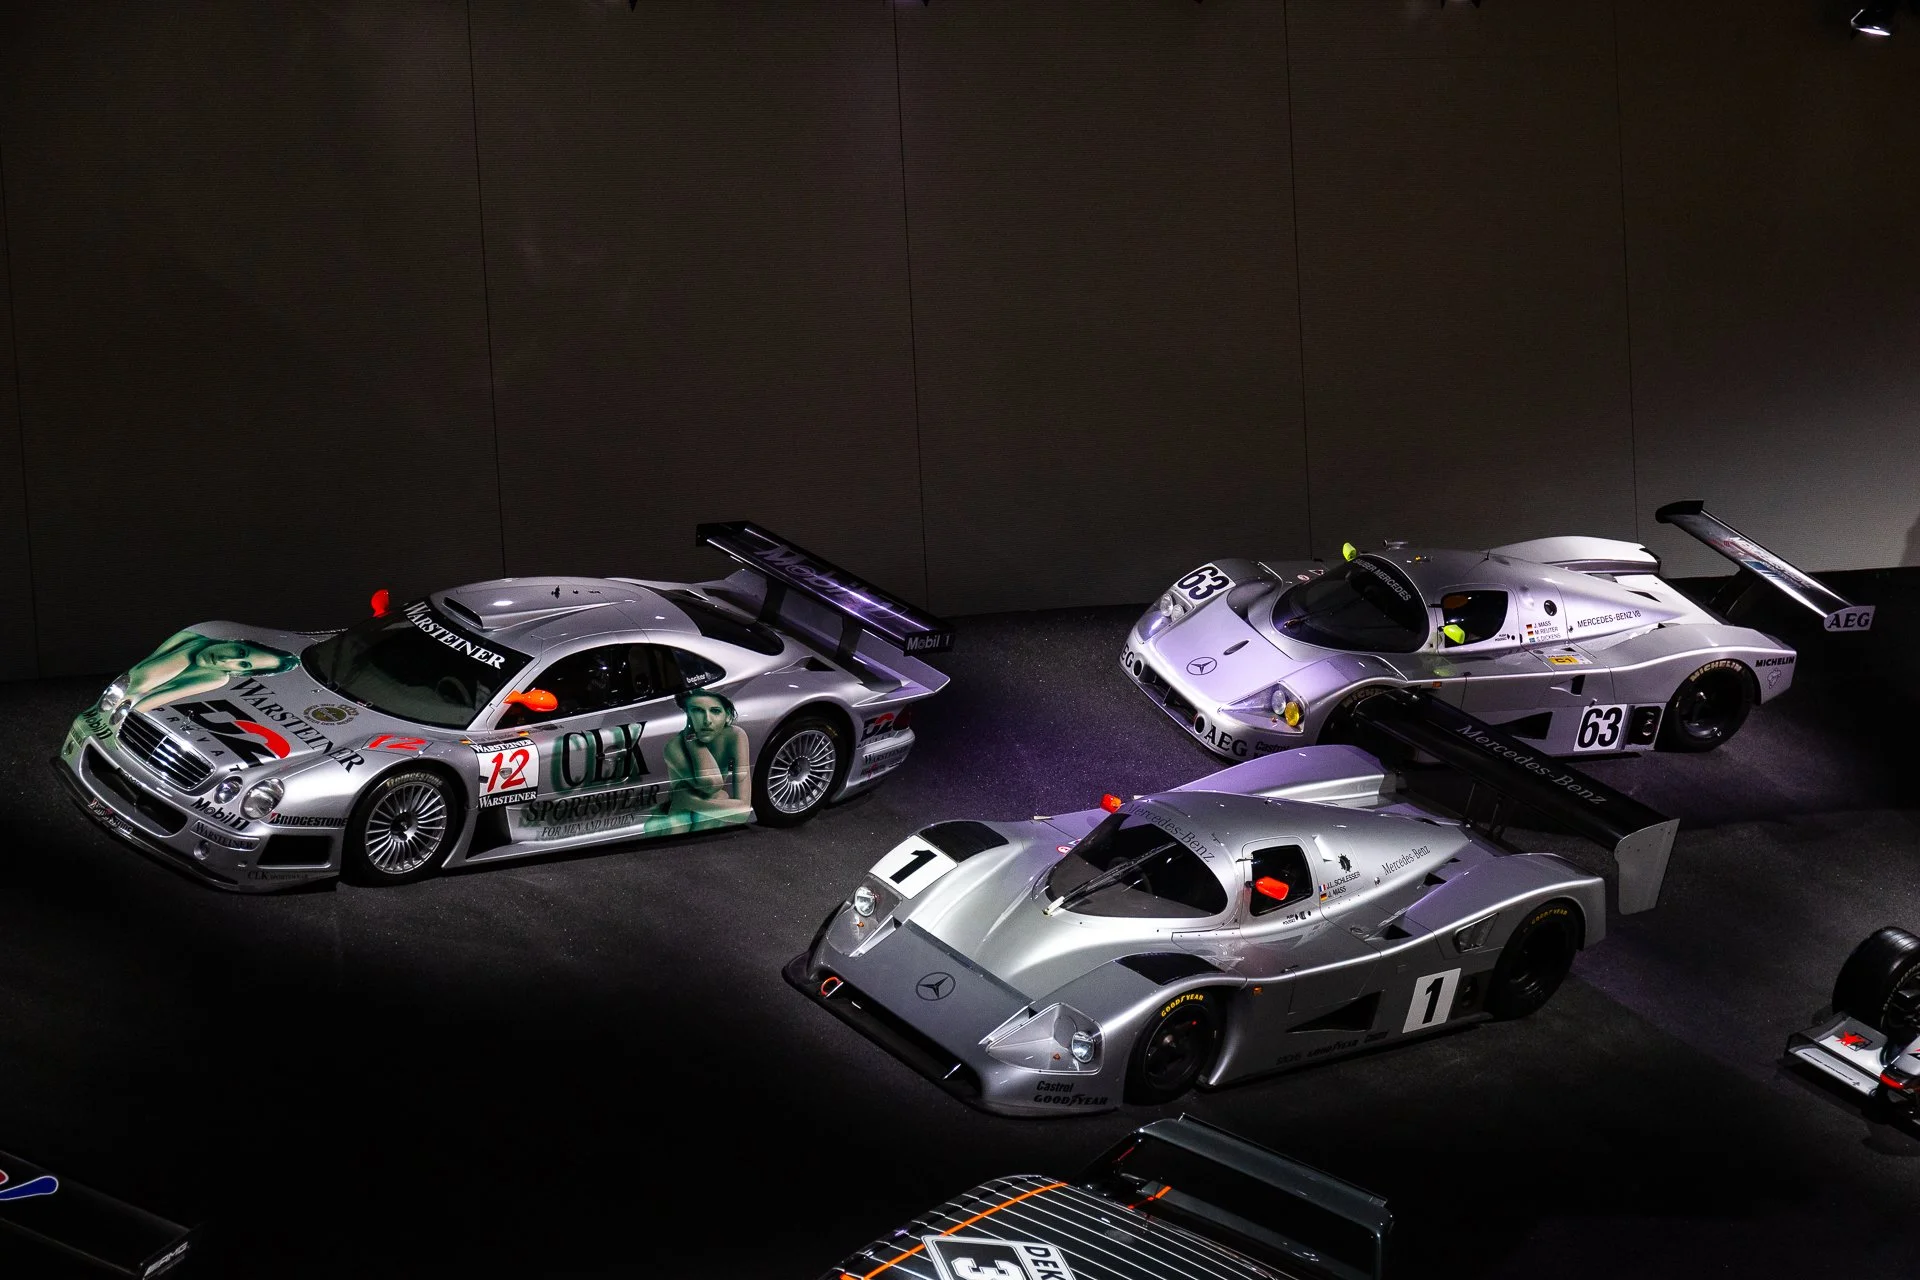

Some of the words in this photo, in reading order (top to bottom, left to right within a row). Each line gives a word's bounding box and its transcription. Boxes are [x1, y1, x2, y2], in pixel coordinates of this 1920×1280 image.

[1177, 566, 1230, 600] 63
[1373, 569, 1411, 601] MERCEDES
[1577, 611, 1633, 628] MERCEDES-BENZ
[1827, 612, 1870, 628] AEG
[403, 601, 506, 669] WARSTEINER
[907, 635, 940, 650] Mobil
[1690, 660, 1742, 682] MICHELIN
[1756, 656, 1795, 667] MICHELIN
[230, 677, 365, 773] WARSTEINER
[1577, 707, 1622, 749] 63
[368, 734, 426, 751] 12
[470, 739, 534, 753] WARSTEINER
[1203, 724, 1247, 758] AEG
[1255, 740, 1290, 755] Castr
[487, 748, 530, 793] 12
[1456, 724, 1607, 805] Mercedes-Benz
[191, 797, 236, 825] Mobil
[479, 791, 537, 809] WARSTEINER
[526, 784, 660, 822] SPORTSWEAR
[269, 812, 348, 827] BRIDGESTONE
[542, 826, 562, 837] FOR
[564, 823, 583, 834] MEN
[583, 819, 601, 831] AND
[195, 821, 255, 850] WARSTEINER
[1127, 803, 1215, 863] Mercedes-Benz
[889, 849, 938, 884] 1
[1382, 845, 1431, 876] Mercedes-Benz
[1332, 885, 1346, 895] MASS
[1161, 993, 1204, 1017] GOODYEAR
[1422, 977, 1445, 1024] 1
[1036, 1080, 1074, 1092] Castrol
[1034, 1093, 1108, 1107] GOODYEAR
